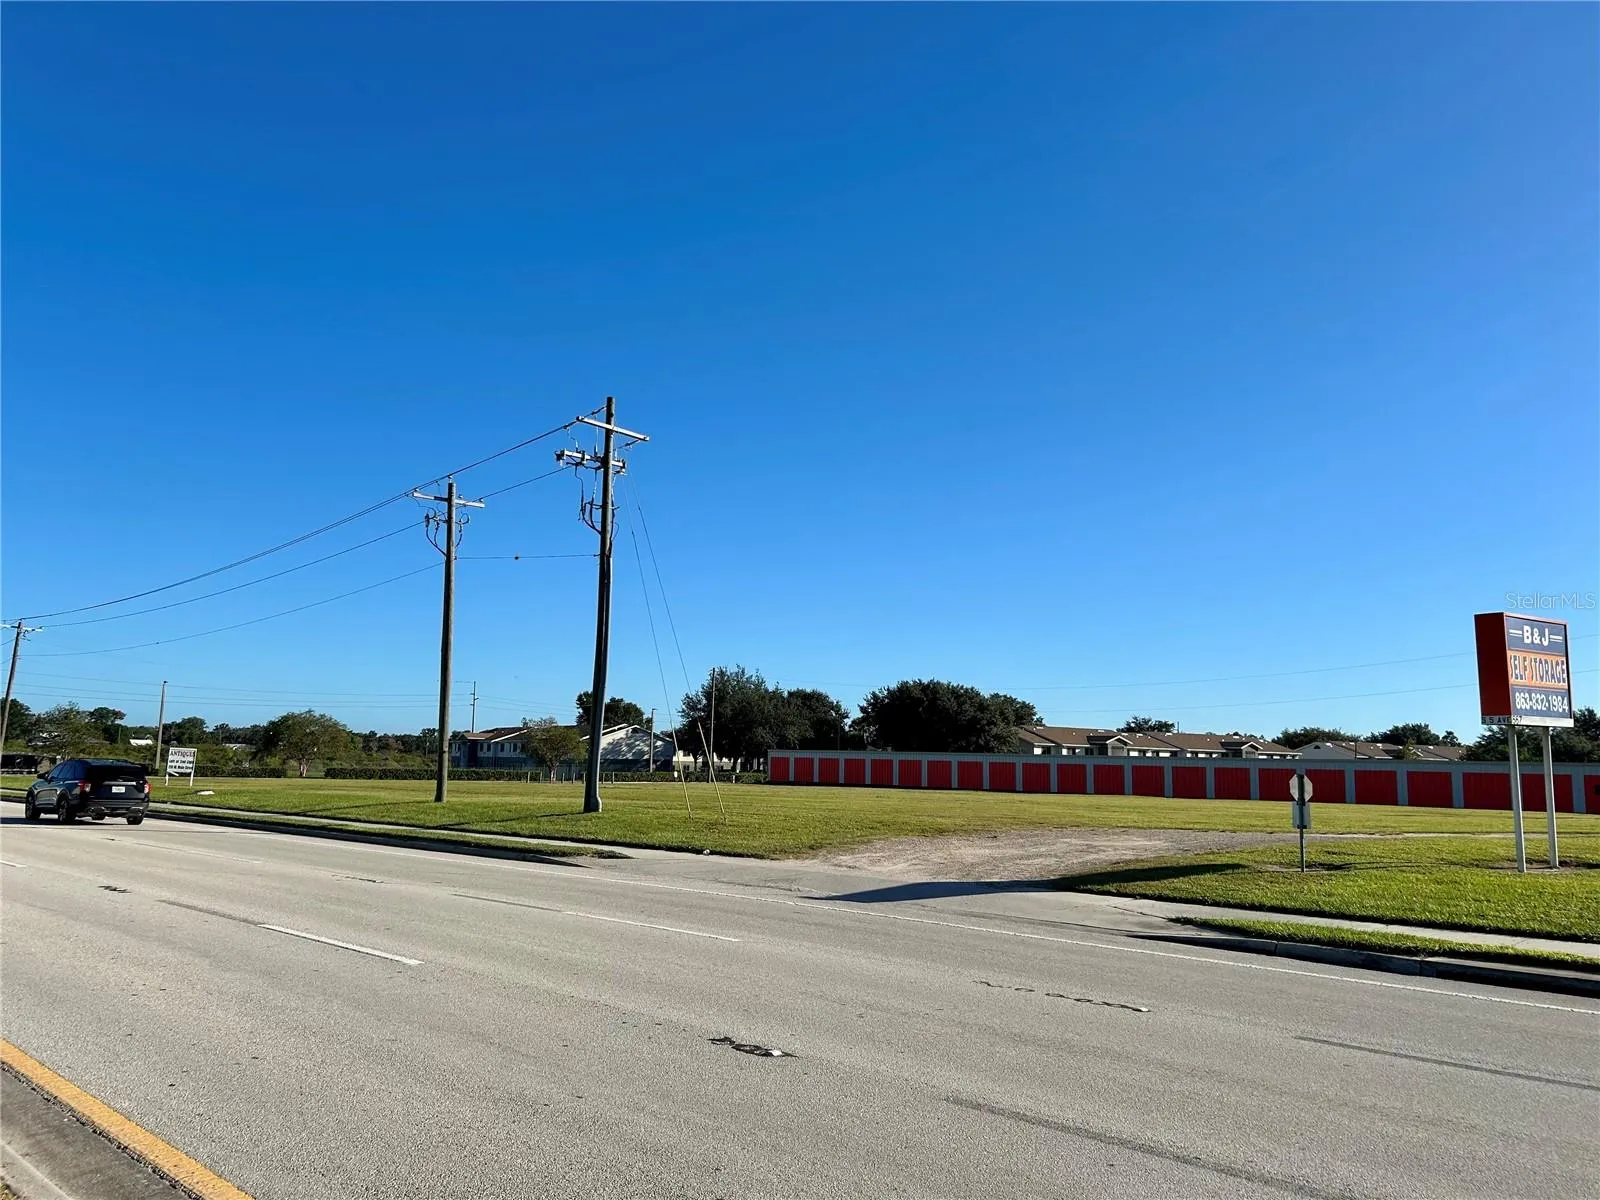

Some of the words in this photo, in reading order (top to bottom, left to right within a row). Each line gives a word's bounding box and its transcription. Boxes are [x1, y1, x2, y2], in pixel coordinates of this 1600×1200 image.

[1510, 654, 1528, 681] SELF
[1530, 657, 1567, 684] STORAGE
[1515, 692, 1568, 713] 863-832-1984
